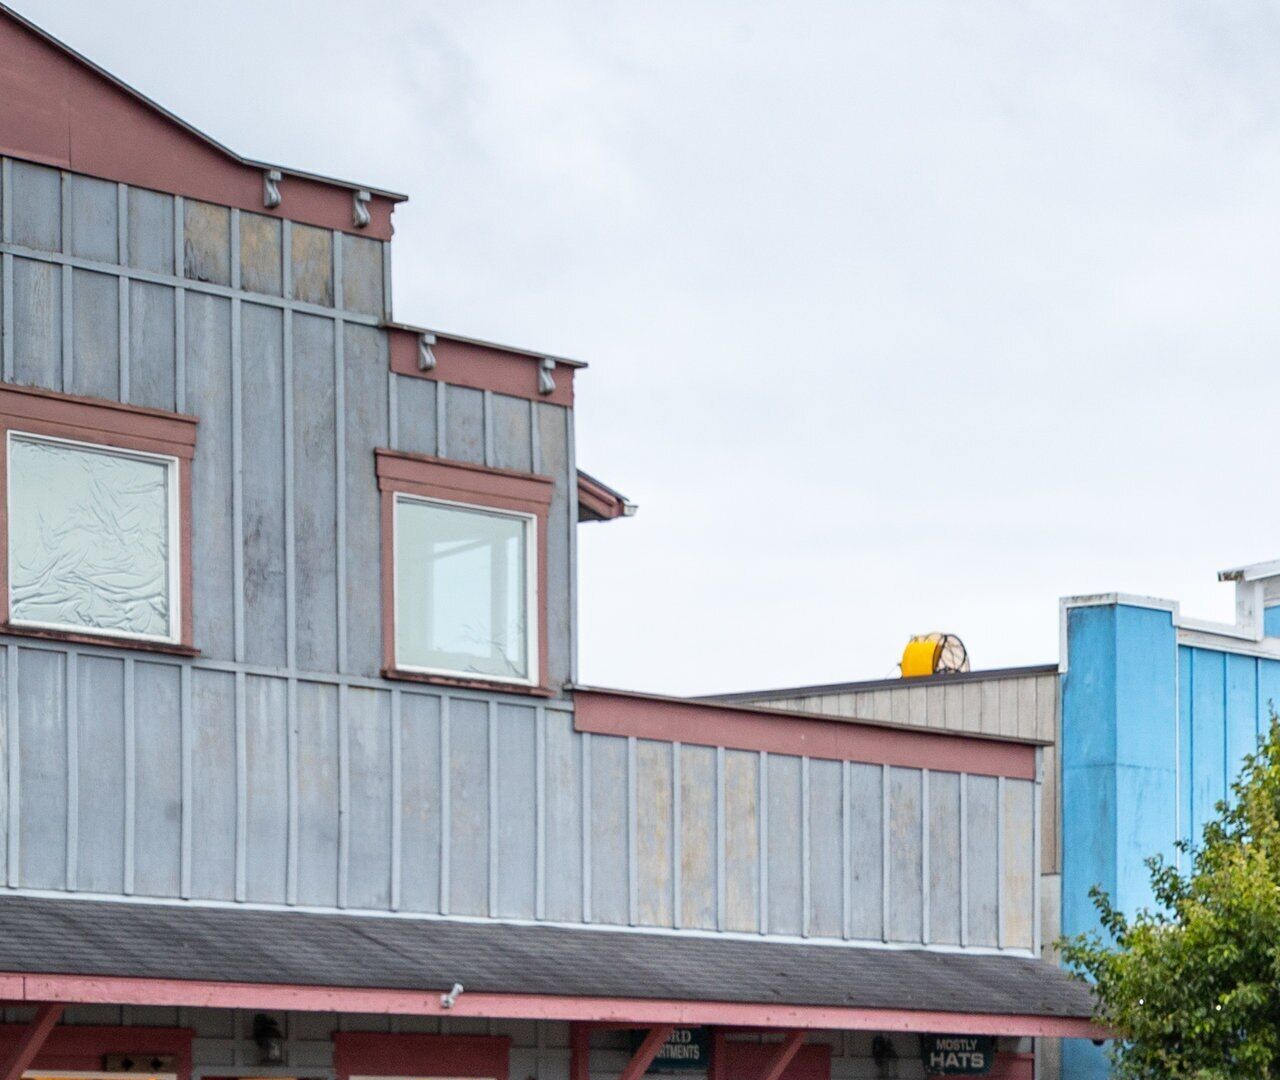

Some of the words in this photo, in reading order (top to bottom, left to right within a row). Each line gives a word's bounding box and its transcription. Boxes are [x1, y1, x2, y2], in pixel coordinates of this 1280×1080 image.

[667, 1030, 692, 1043] RD
[936, 1039, 978, 1052] MOSTLY
[930, 1053, 985, 1069] HATS
